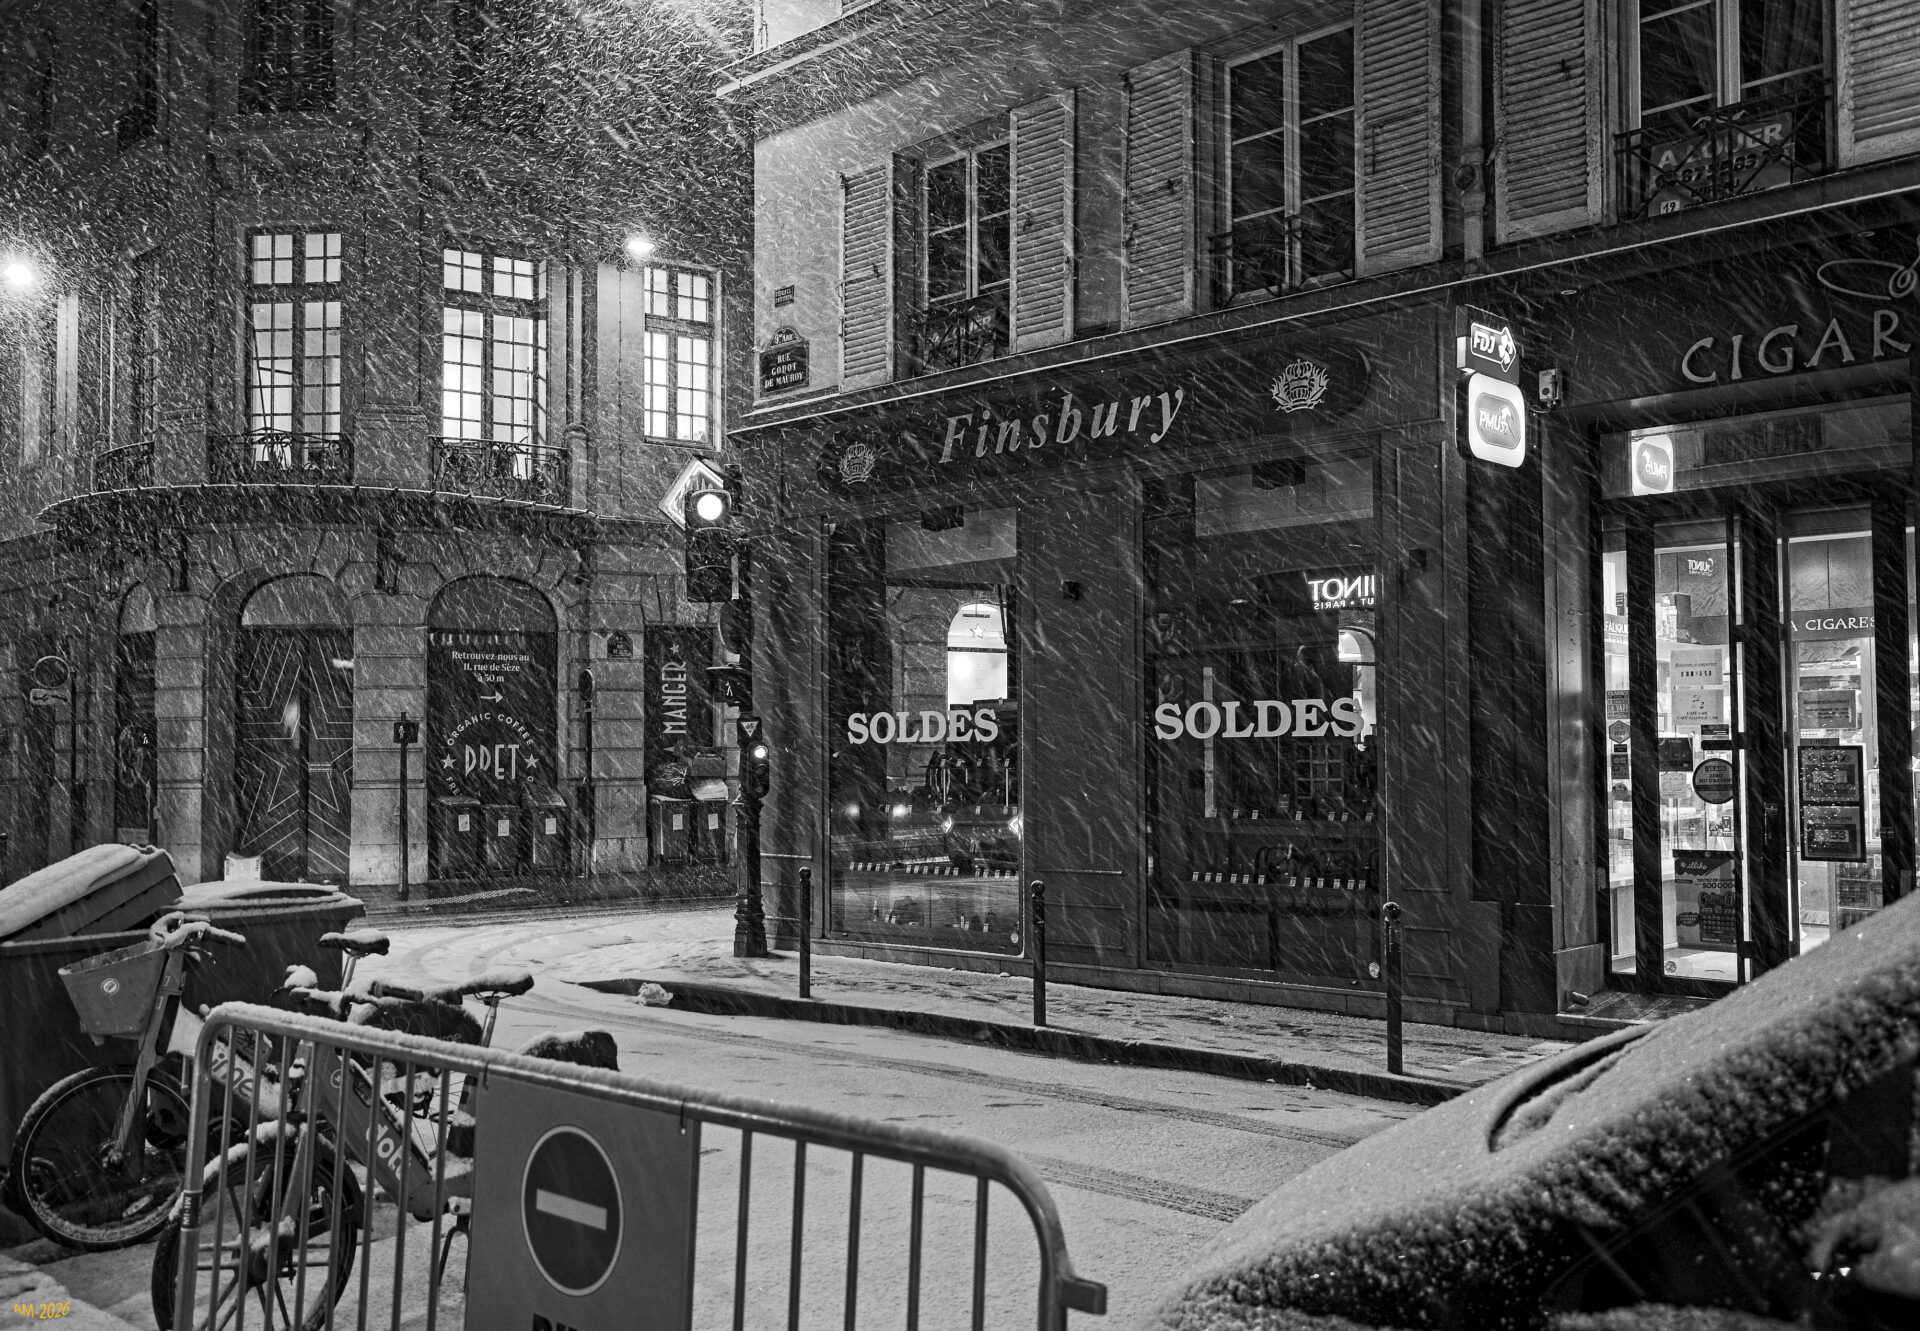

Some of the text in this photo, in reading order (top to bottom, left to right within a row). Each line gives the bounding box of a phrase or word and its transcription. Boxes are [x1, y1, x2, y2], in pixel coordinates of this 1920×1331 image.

[1658, 150, 1678, 168] A
[1686, 123, 1785, 164] LOUER
[1473, 330, 1496, 354] FDJ
[771, 362, 798, 376] GODOT
[777, 352, 791, 364] RUE
[764, 372, 804, 389] DE MAUROY
[938, 388, 1185, 464] Finsbury
[1479, 410, 1502, 433] PMU
[473, 664, 488, 672] rue
[490, 662, 500, 672] de
[519, 653, 530, 662] au
[484, 673, 495, 682] 50
[662, 661, 687, 734] MANGER
[446, 712, 534, 746] ORGANIC COFFEE
[848, 708, 999, 745] SOLDES
[1154, 697, 1364, 741] SOLDES
[446, 777, 461, 795] FRE
